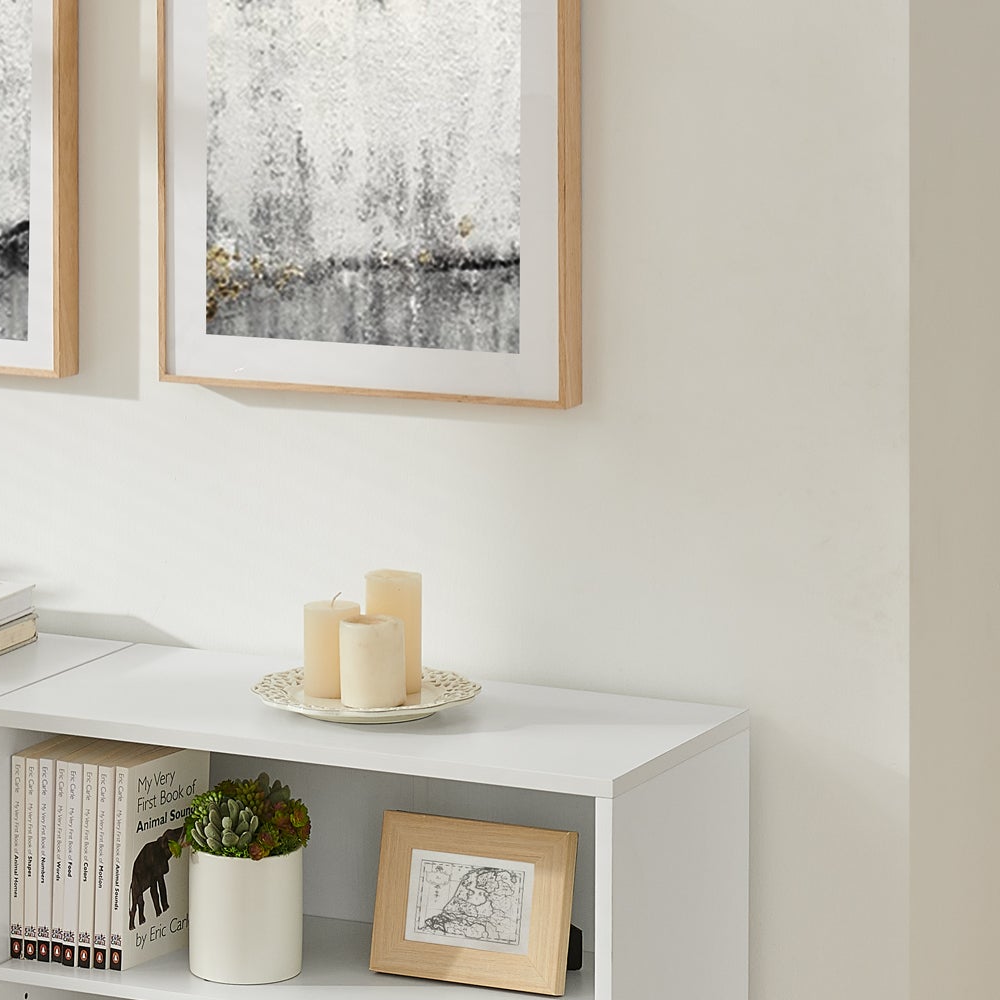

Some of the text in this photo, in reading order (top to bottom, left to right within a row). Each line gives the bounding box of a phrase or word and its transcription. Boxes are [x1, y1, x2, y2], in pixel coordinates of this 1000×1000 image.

[41, 766, 49, 796] Eric Carle
[137, 771, 176, 795] My Very
[137, 779, 197, 813] First Book of
[136, 805, 196, 833] Animal Sound
[136, 932, 148, 950] by
[150, 923, 167, 942] Eric
[169, 913, 189, 933] Carl
